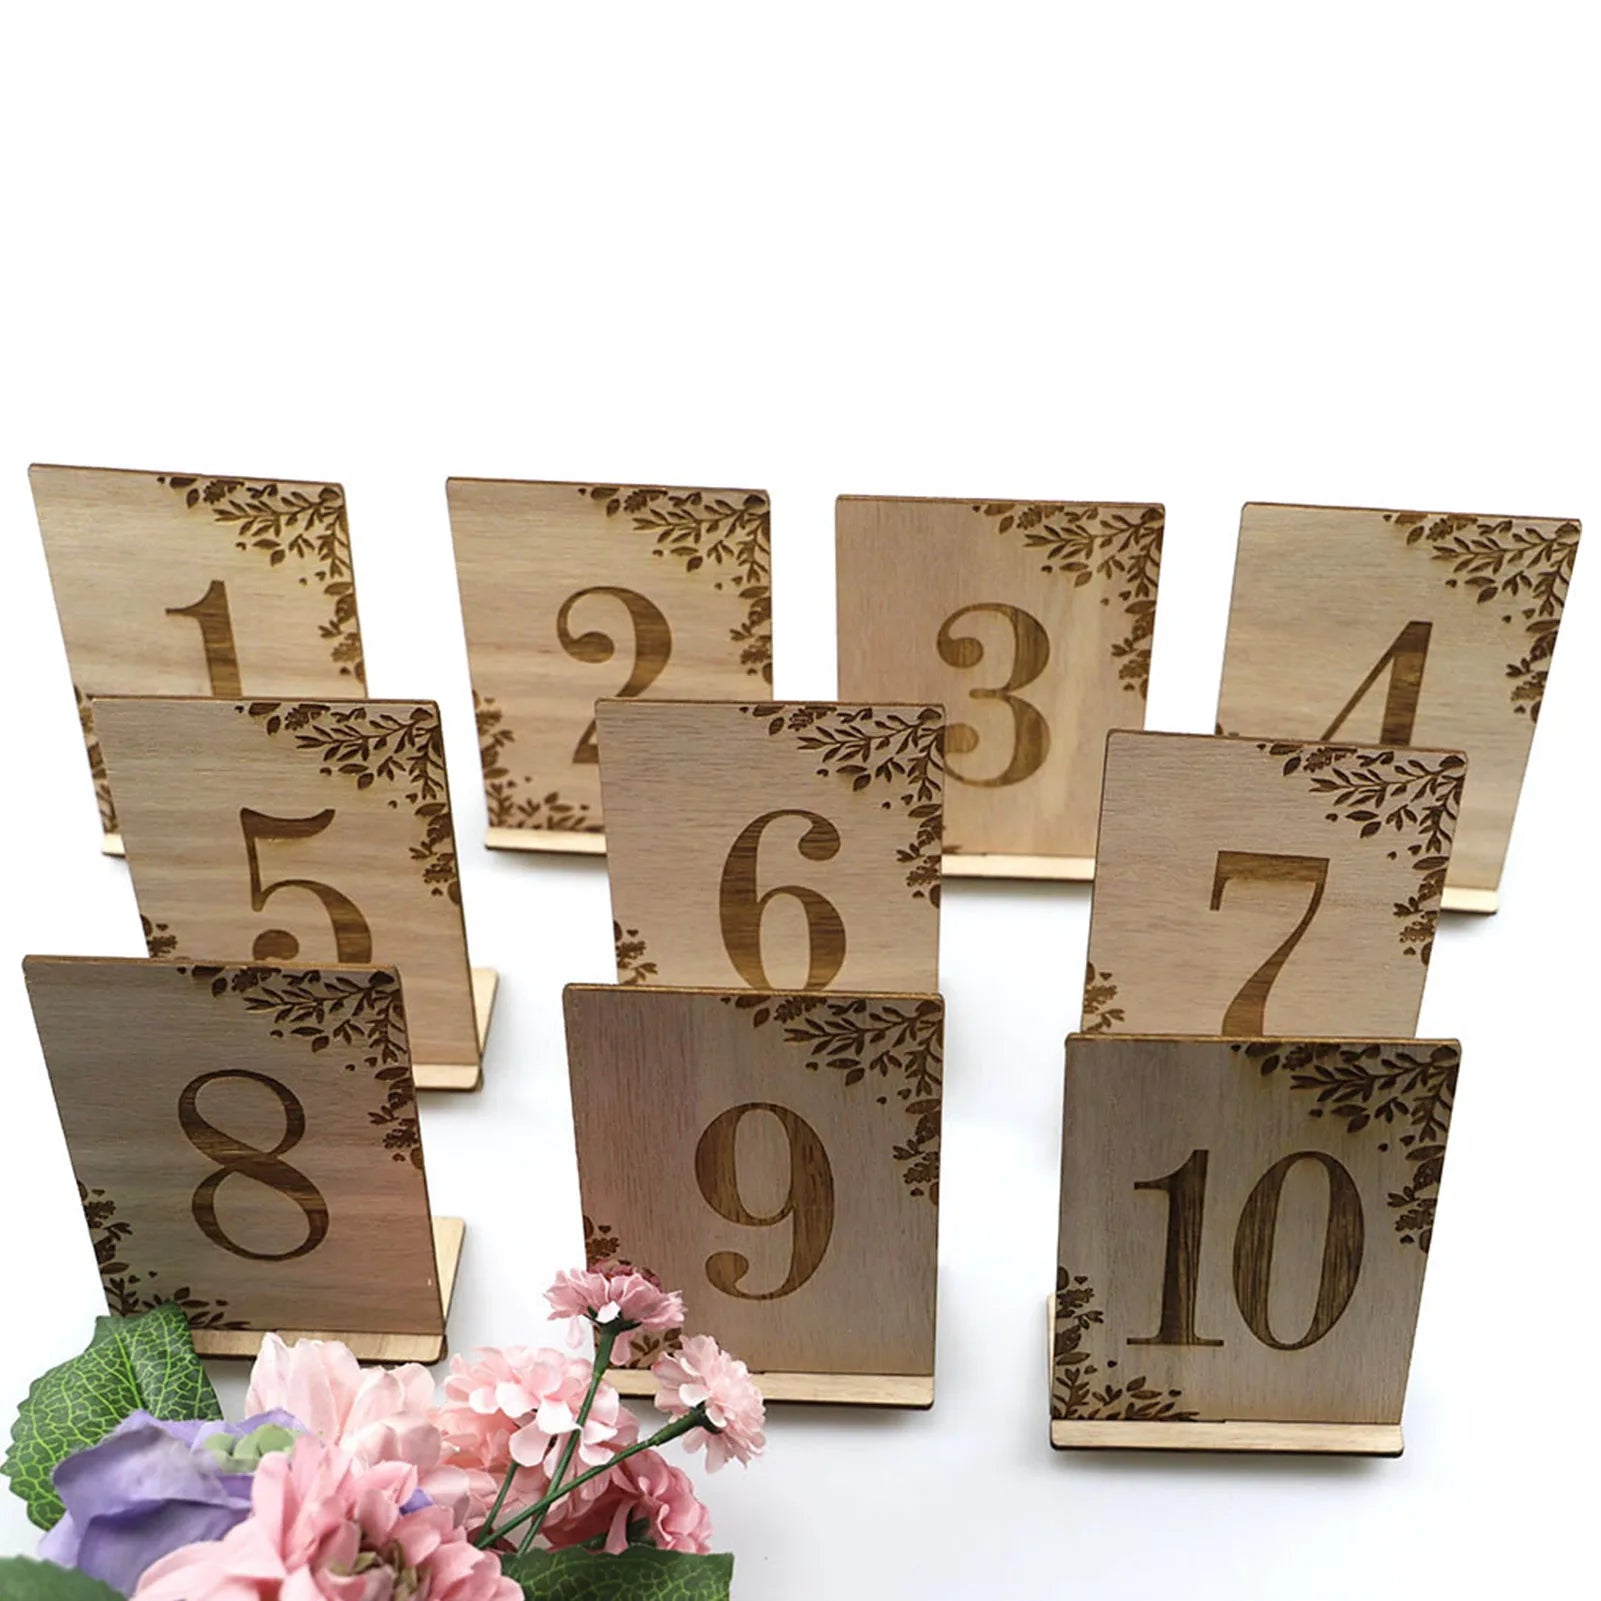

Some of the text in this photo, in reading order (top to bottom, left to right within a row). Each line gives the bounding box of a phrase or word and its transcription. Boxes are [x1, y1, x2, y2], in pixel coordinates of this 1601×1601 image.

[165, 580, 242, 697] 1
[556, 586, 673, 764] 2
[936, 602, 1051, 788] 3
[1320, 621, 1433, 746] 4
[240, 807, 373, 963] 5
[719, 809, 847, 992] 6
[1209, 850, 1330, 1037] 7
[178, 1069, 330, 1262] 8
[695, 1102, 835, 1301] 9
[1126, 1148, 1366, 1351] 10
